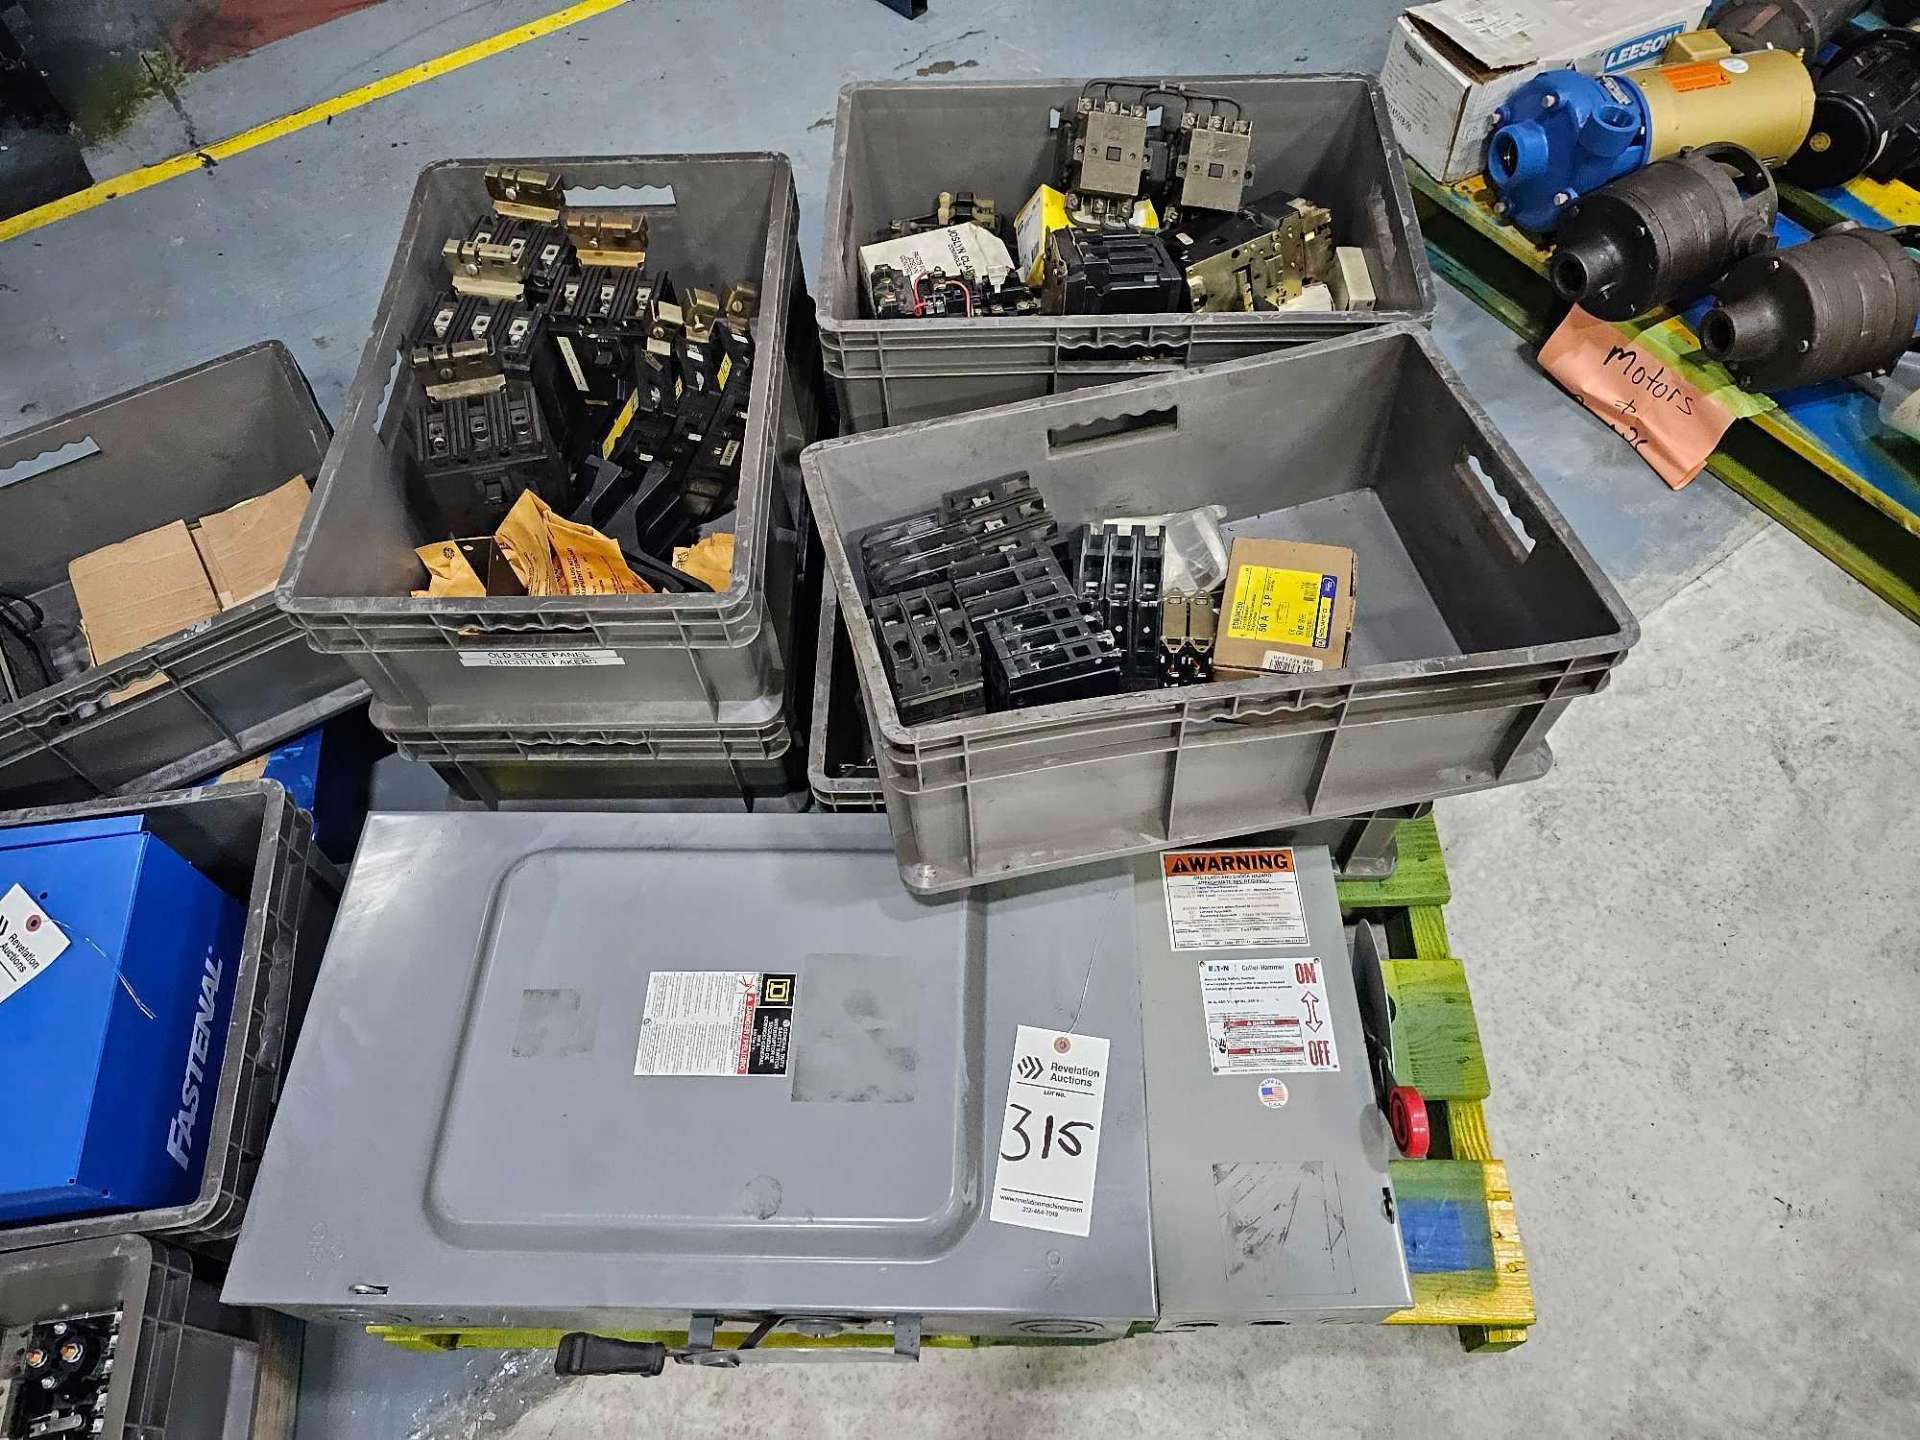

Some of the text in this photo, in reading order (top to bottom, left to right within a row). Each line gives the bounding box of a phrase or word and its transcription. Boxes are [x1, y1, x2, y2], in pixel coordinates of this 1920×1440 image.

[1603, 345, 1694, 416] Motors
[513, 651, 549, 659] STYLE
[1188, 854, 1288, 873] WARNING
[0, 943, 26, 973] Auctions
[8, 933, 40, 970] Revelation
[1295, 963, 1317, 984] ON
[744, 1005, 753, 1034] DANGER
[167, 957, 223, 1171] FASTENAL
[1308, 1040, 1331, 1066] OFF
[1050, 1061, 1100, 1079] Revelation
[1050, 1072, 1094, 1087] Auctions
[1001, 1103, 1094, 1162] 315
